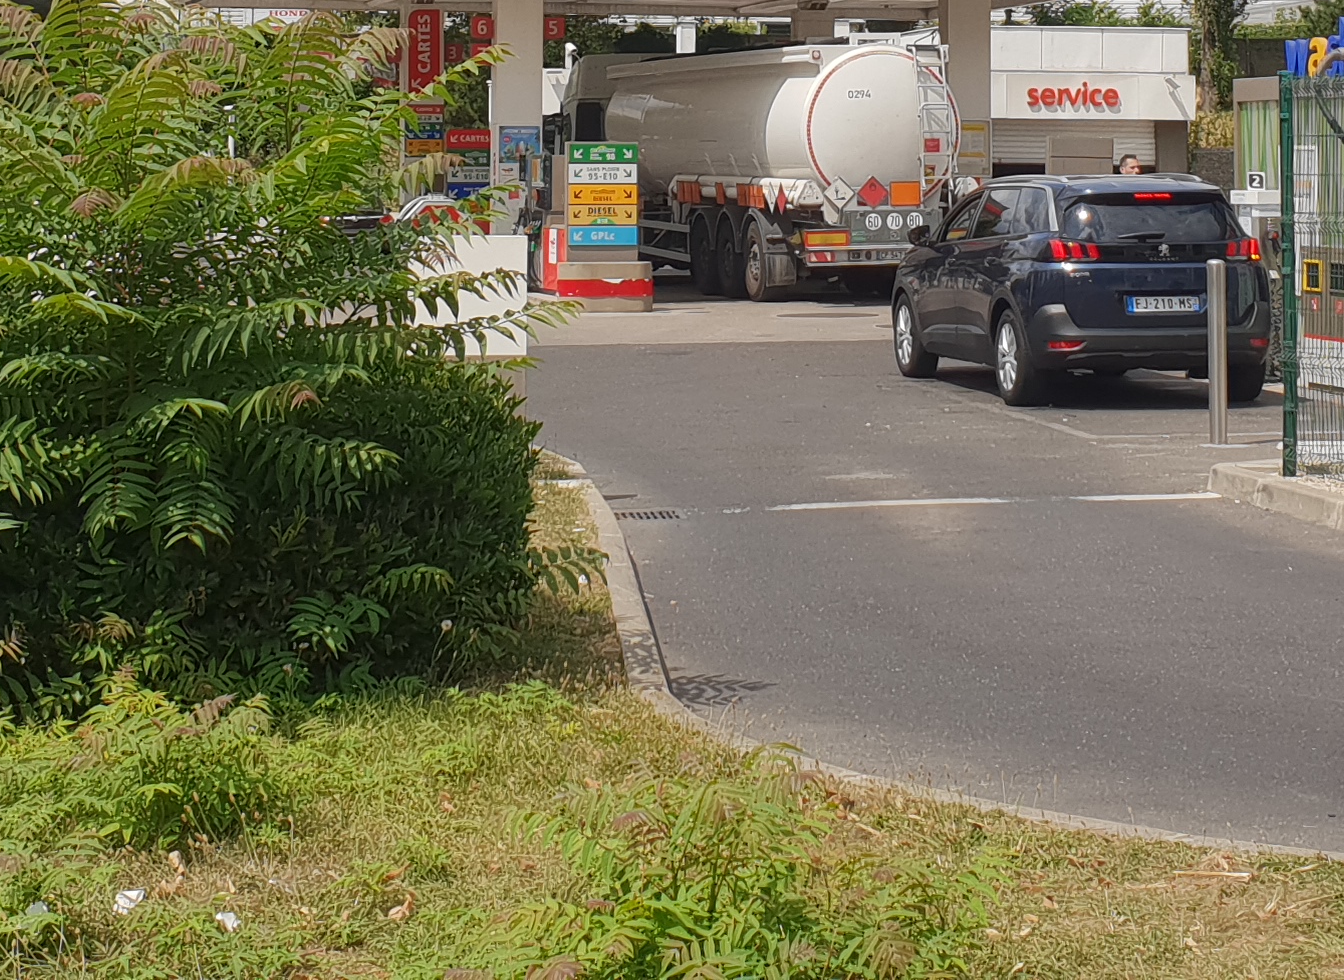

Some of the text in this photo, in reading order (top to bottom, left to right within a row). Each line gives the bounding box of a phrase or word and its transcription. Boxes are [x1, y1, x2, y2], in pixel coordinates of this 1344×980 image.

[476, 20, 488, 35] 6
[548, 21, 558, 35] 5
[417, 14, 431, 73] CARTES
[448, 46, 457, 60] 3
[847, 89, 871, 99] 0294
[1027, 81, 1119, 107] service
[459, 135, 489, 143] CARTES
[587, 172, 618, 180] 95-E10
[1251, 176, 1261, 187] 2
[587, 206, 617, 215] DIESEL
[867, 215, 881, 228] 60
[889, 215, 900, 227] 70
[908, 214, 920, 227] 80
